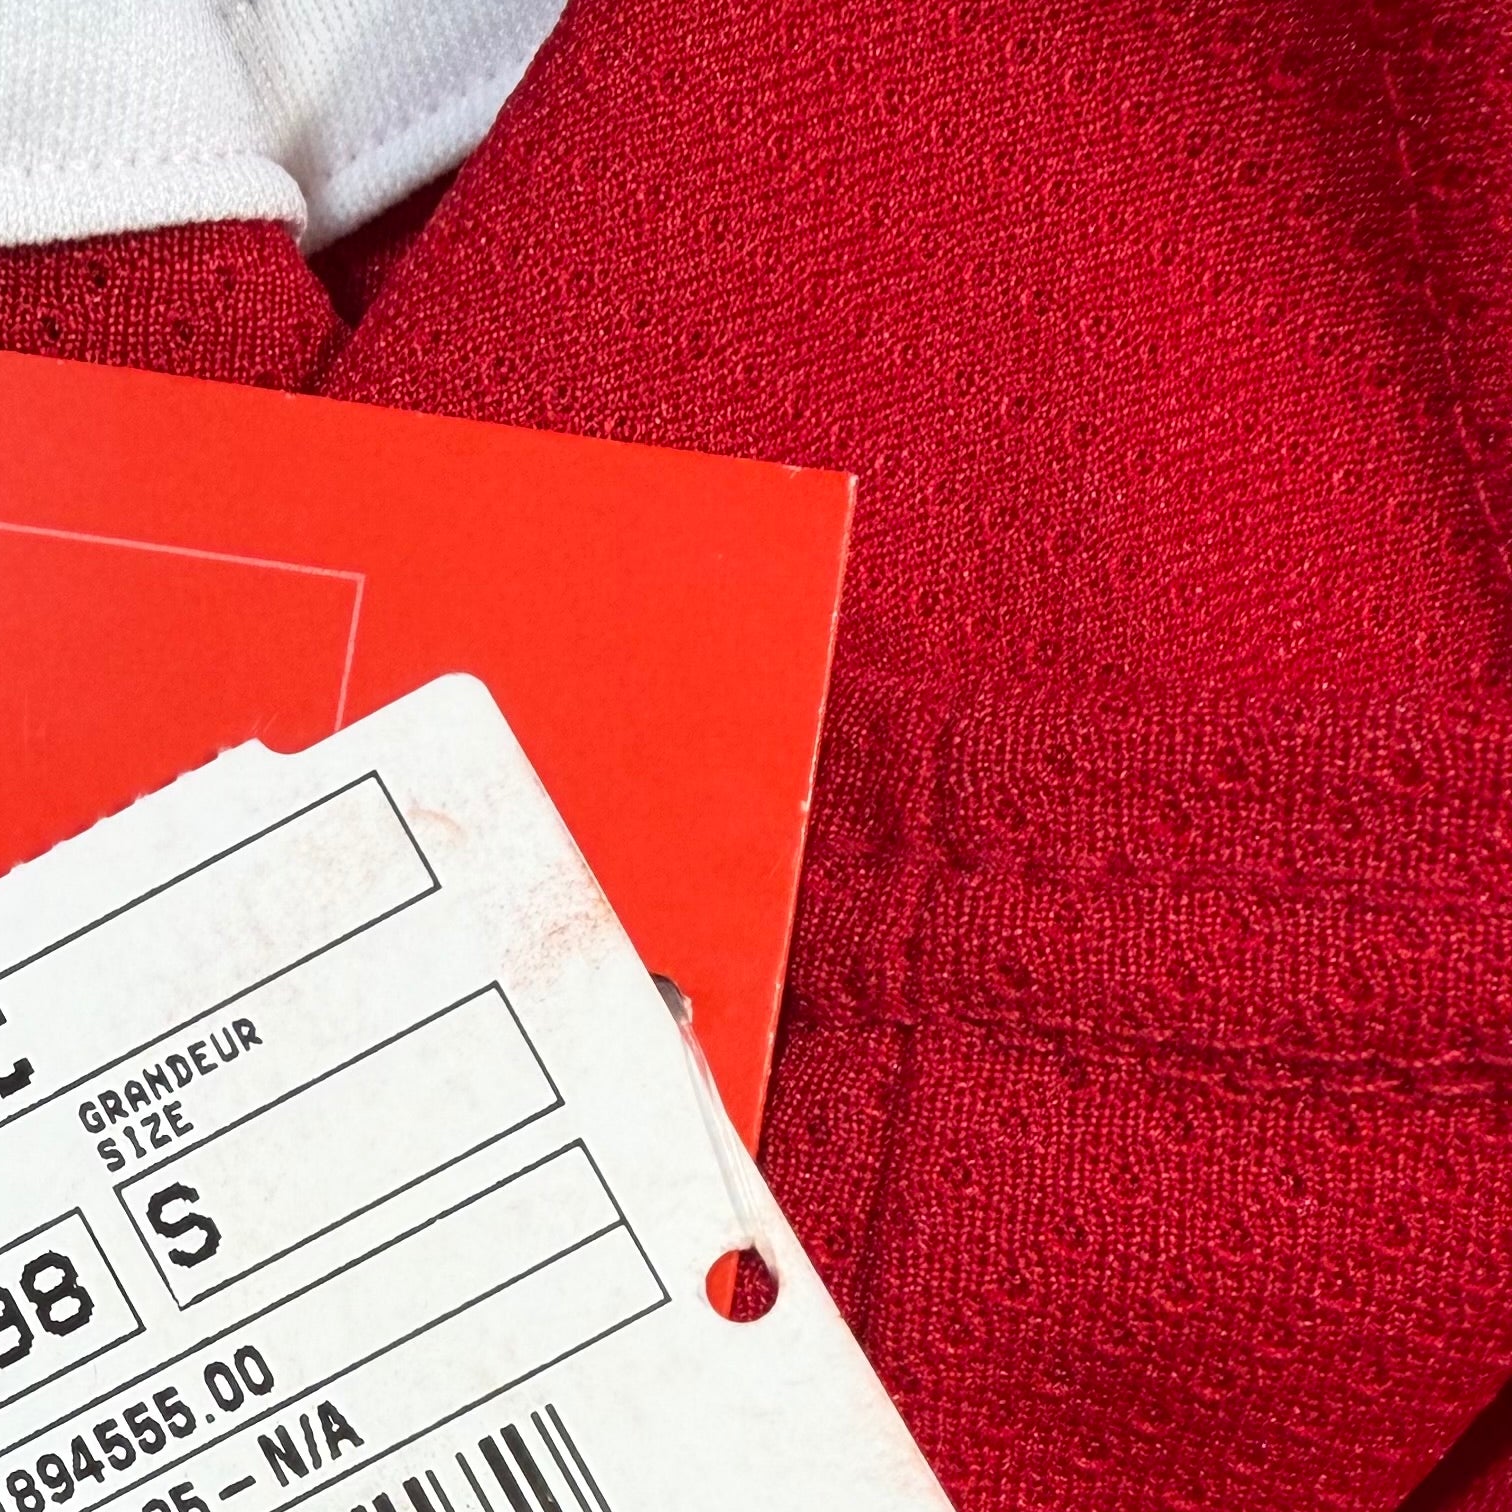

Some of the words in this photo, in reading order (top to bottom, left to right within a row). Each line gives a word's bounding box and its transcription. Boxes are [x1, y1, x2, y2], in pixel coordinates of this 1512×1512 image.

[79, 1018, 262, 1133] GRANDEUR
[97, 1100, 194, 1172] SIZE
[146, 1181, 221, 1268] S
